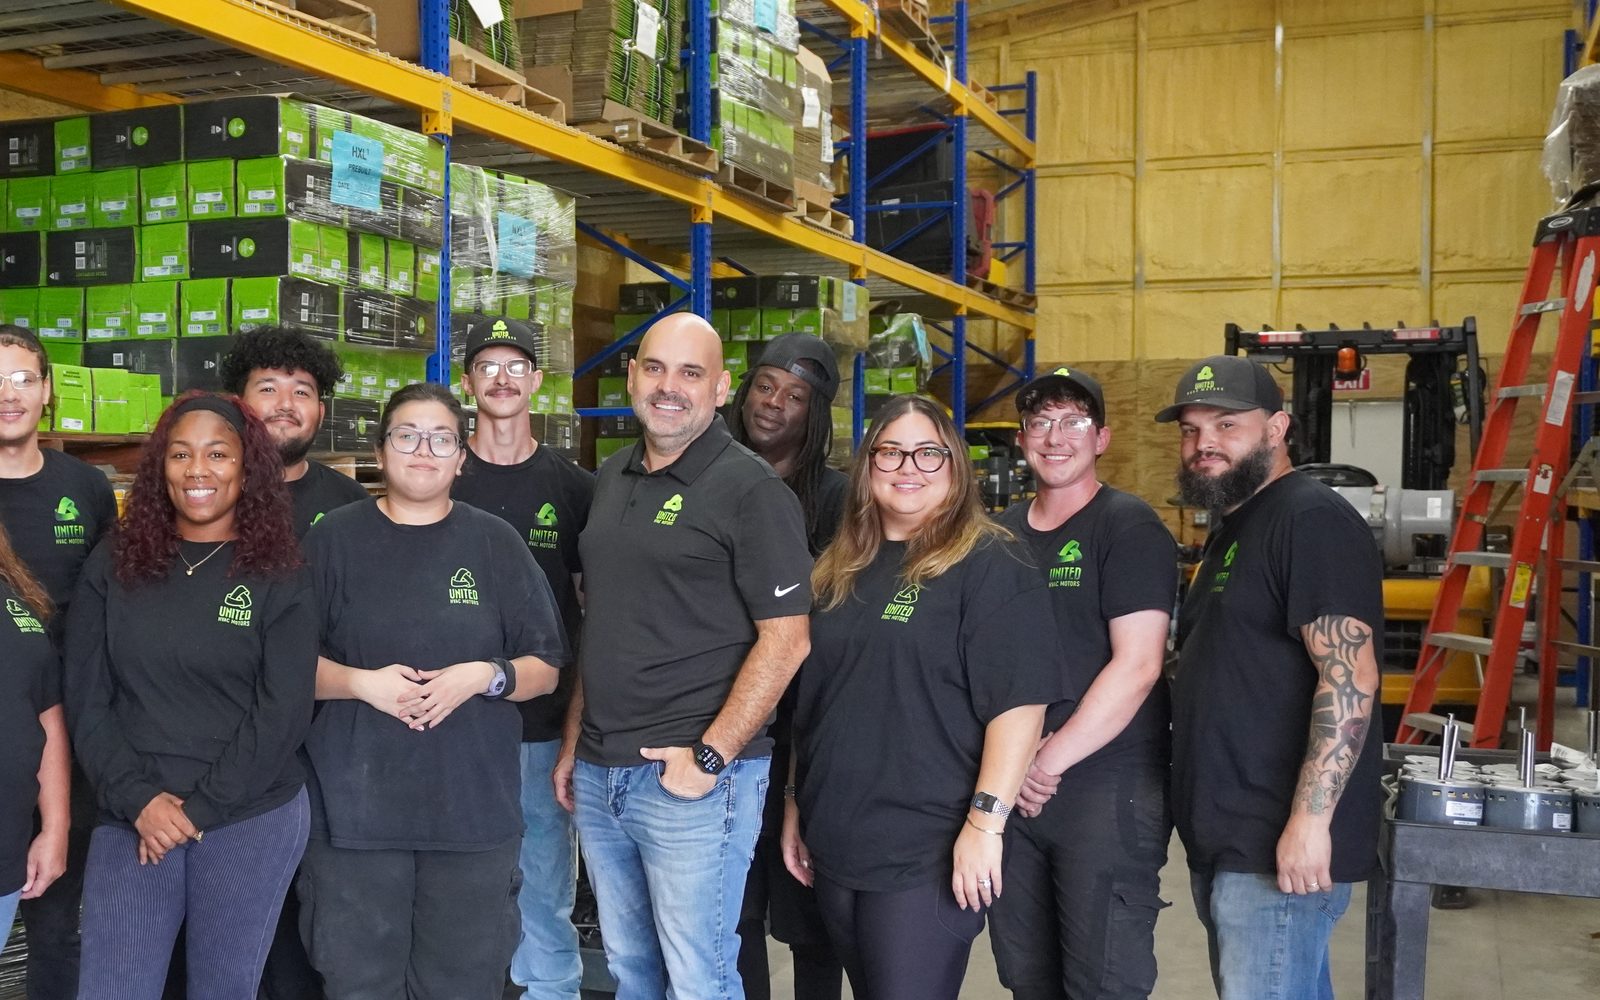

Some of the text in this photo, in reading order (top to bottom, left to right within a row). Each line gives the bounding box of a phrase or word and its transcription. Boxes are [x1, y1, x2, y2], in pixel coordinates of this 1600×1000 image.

[655, 510, 677, 521] UNITED
[53, 525, 84, 538] UNITED
[530, 528, 558, 543] UNITED
[1049, 566, 1082, 580] UNITED
[449, 588, 479, 600] UNITED
[218, 605, 251, 620] UNITED
[883, 602, 914, 617] UNITED
[12, 616, 42, 628] UNITED
[230, 619, 250, 627] MOTORS
